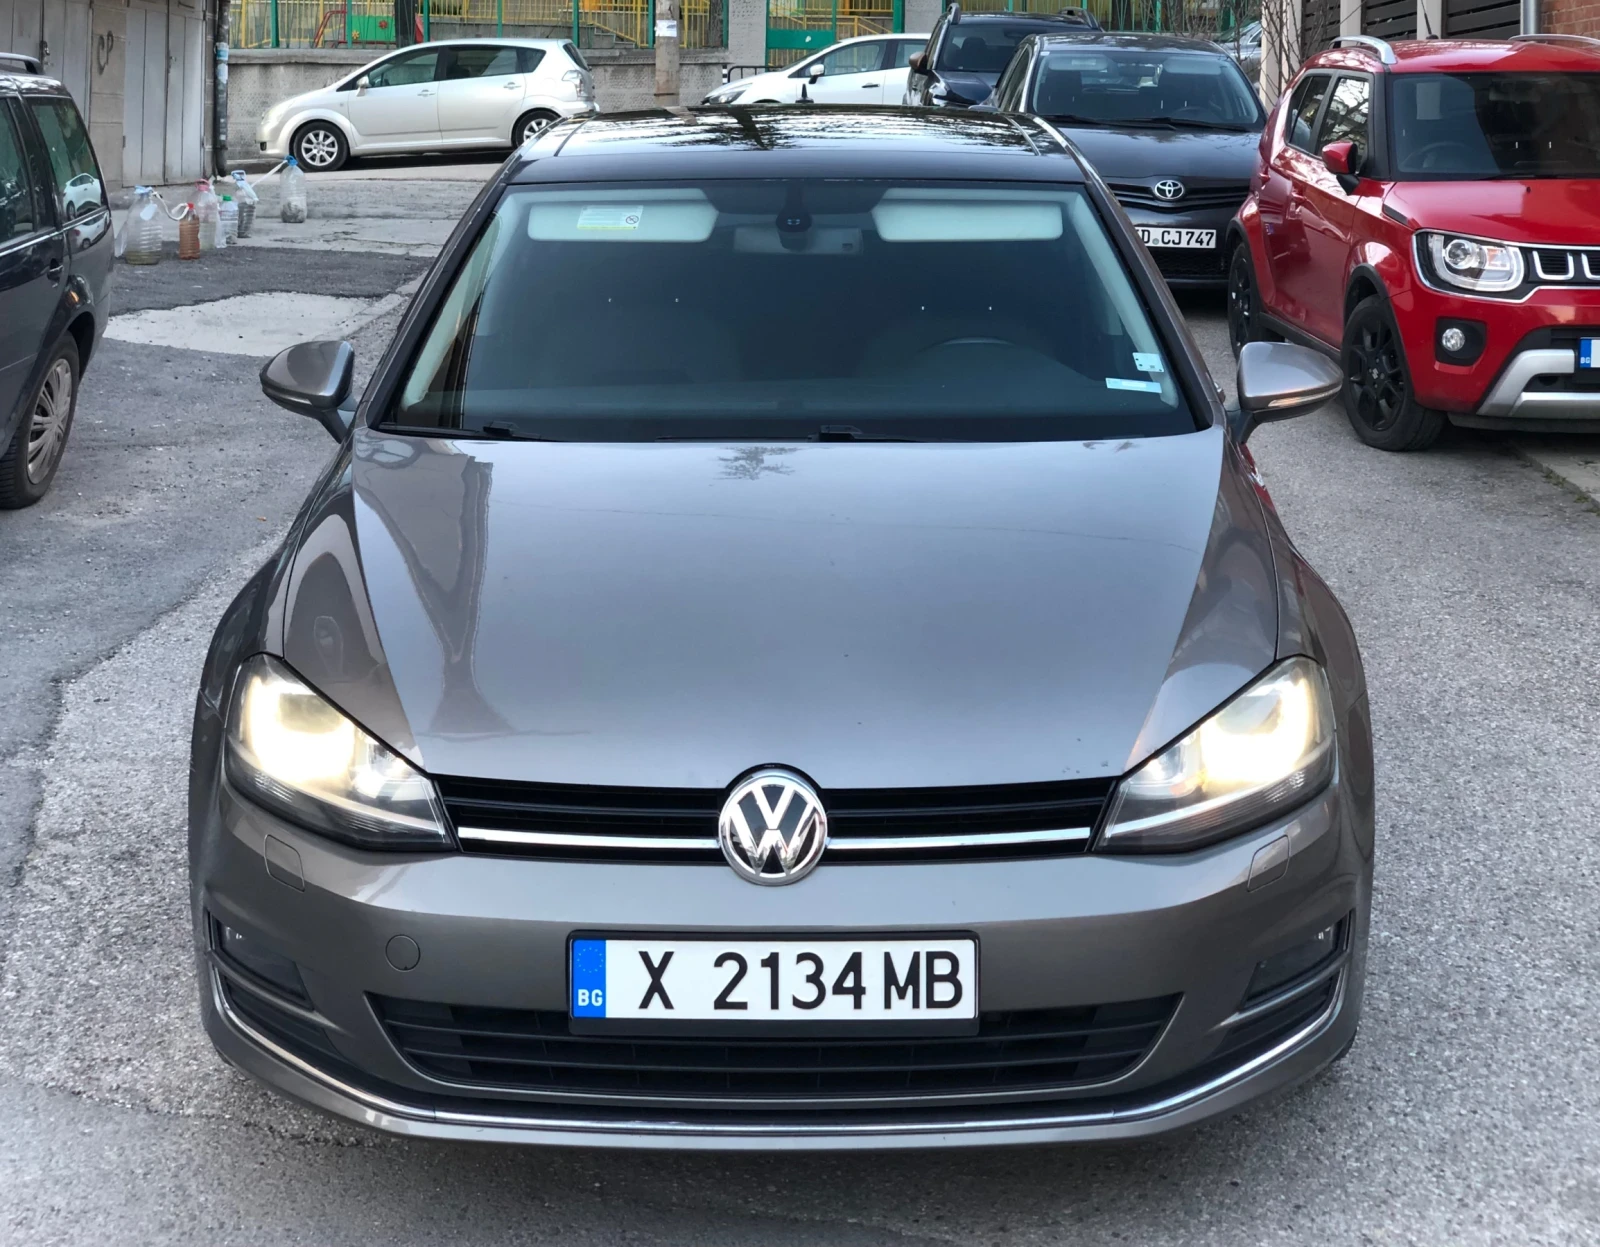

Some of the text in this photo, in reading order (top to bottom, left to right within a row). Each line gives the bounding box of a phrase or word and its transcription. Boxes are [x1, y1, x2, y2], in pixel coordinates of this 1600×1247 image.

[1136, 229, 1151, 244] D
[638, 951, 963, 1010] X 2134 MB
[578, 989, 603, 1006] BG
